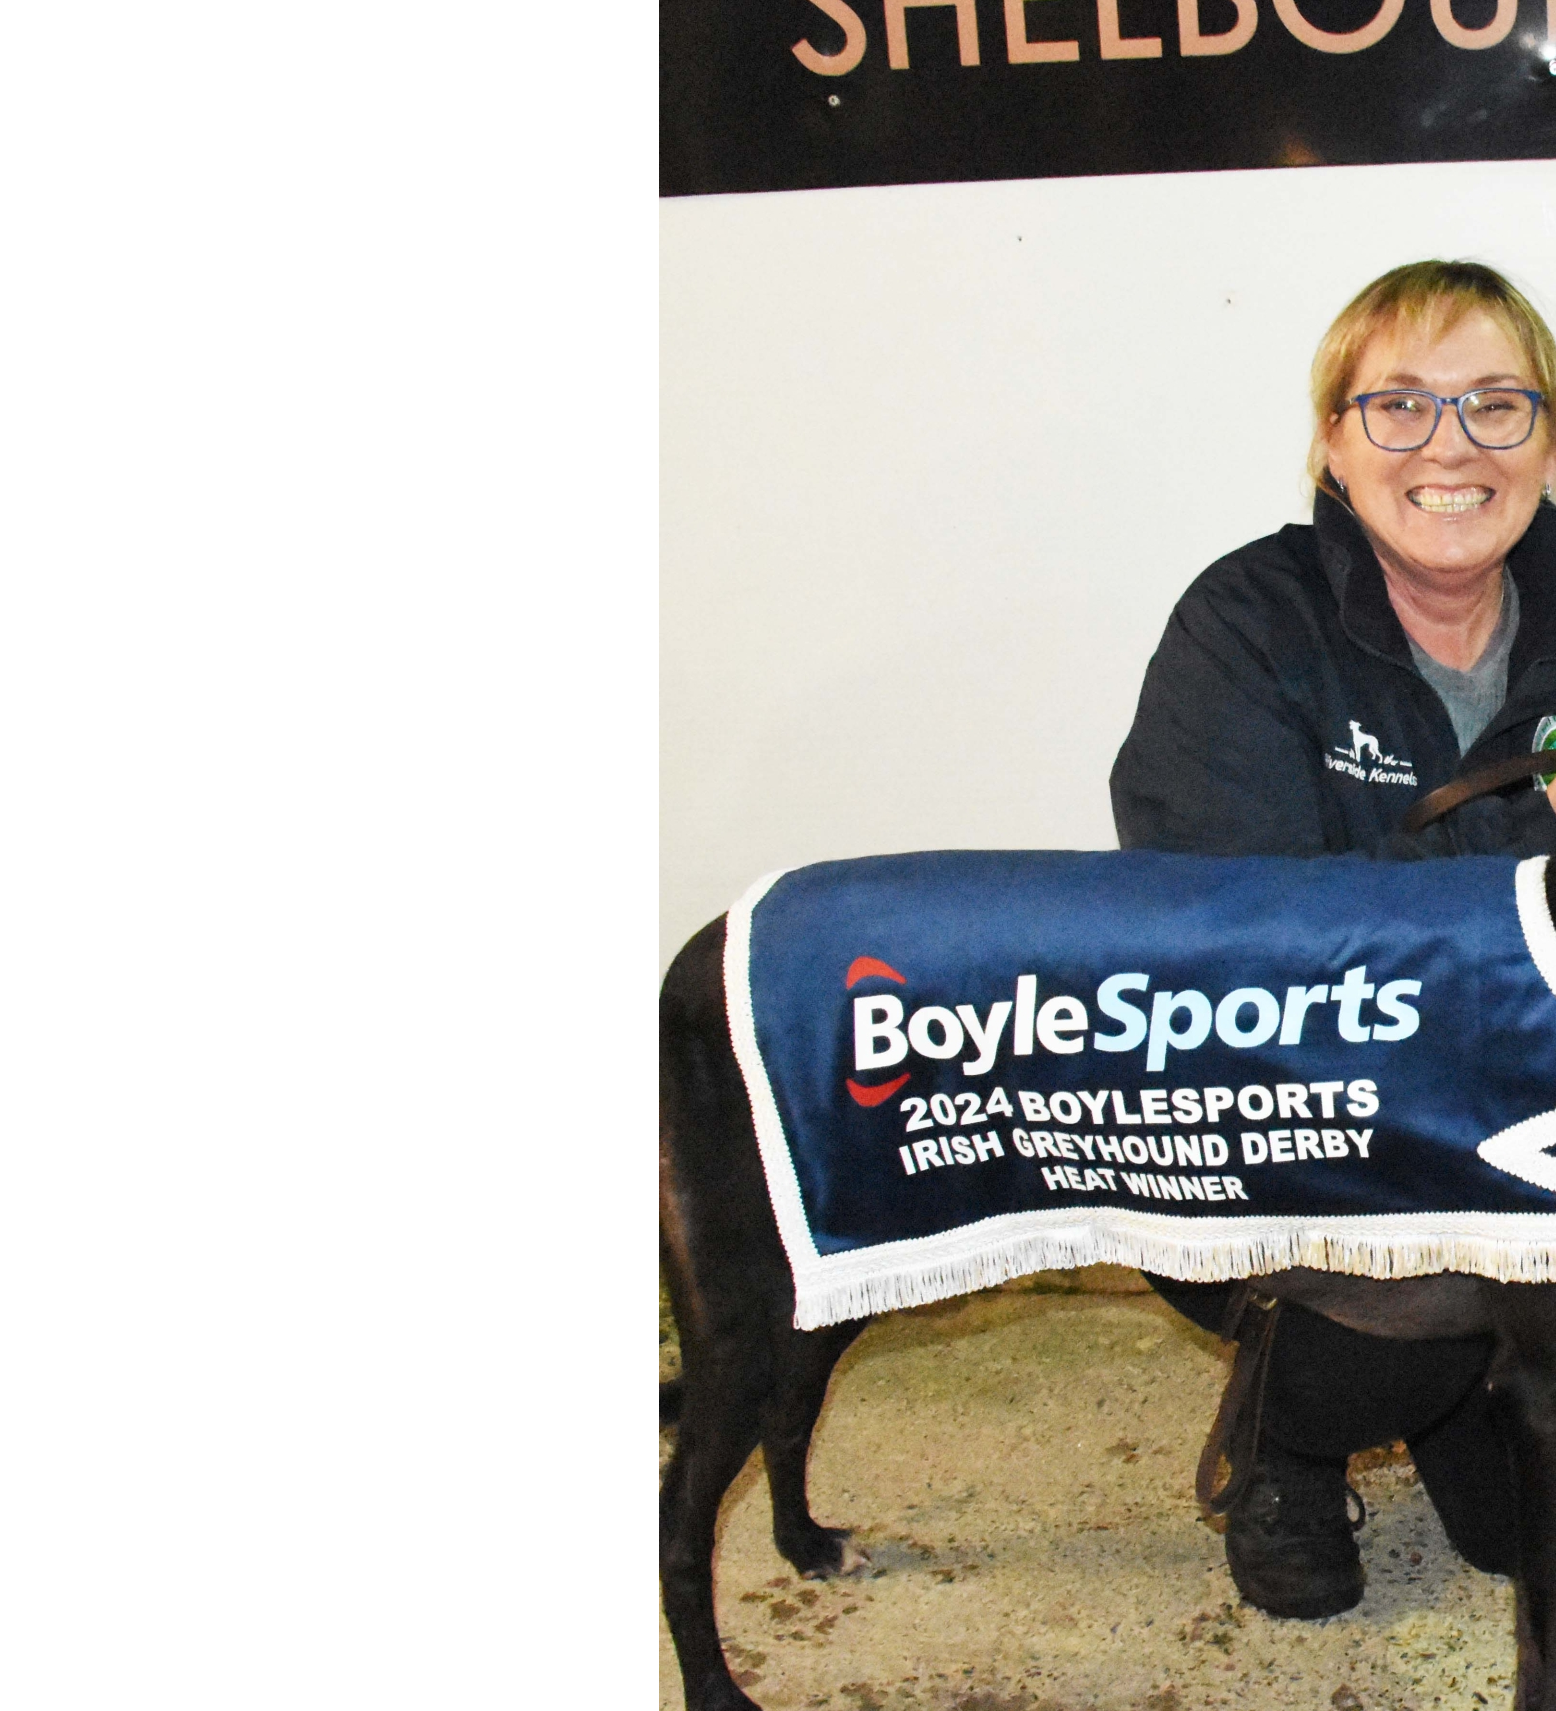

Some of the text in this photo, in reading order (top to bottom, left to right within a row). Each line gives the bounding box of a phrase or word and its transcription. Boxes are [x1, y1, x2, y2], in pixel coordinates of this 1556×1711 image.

[1368, 768, 1418, 787] Kennels
[853, 964, 1422, 1076] BoyleSports
[900, 1079, 1379, 1132] 2024 BOYLESPORTS
[899, 1127, 1374, 1176] IRISH GREYHOUND DERBY
[1041, 1166, 1249, 1201] HEAT WINNER
